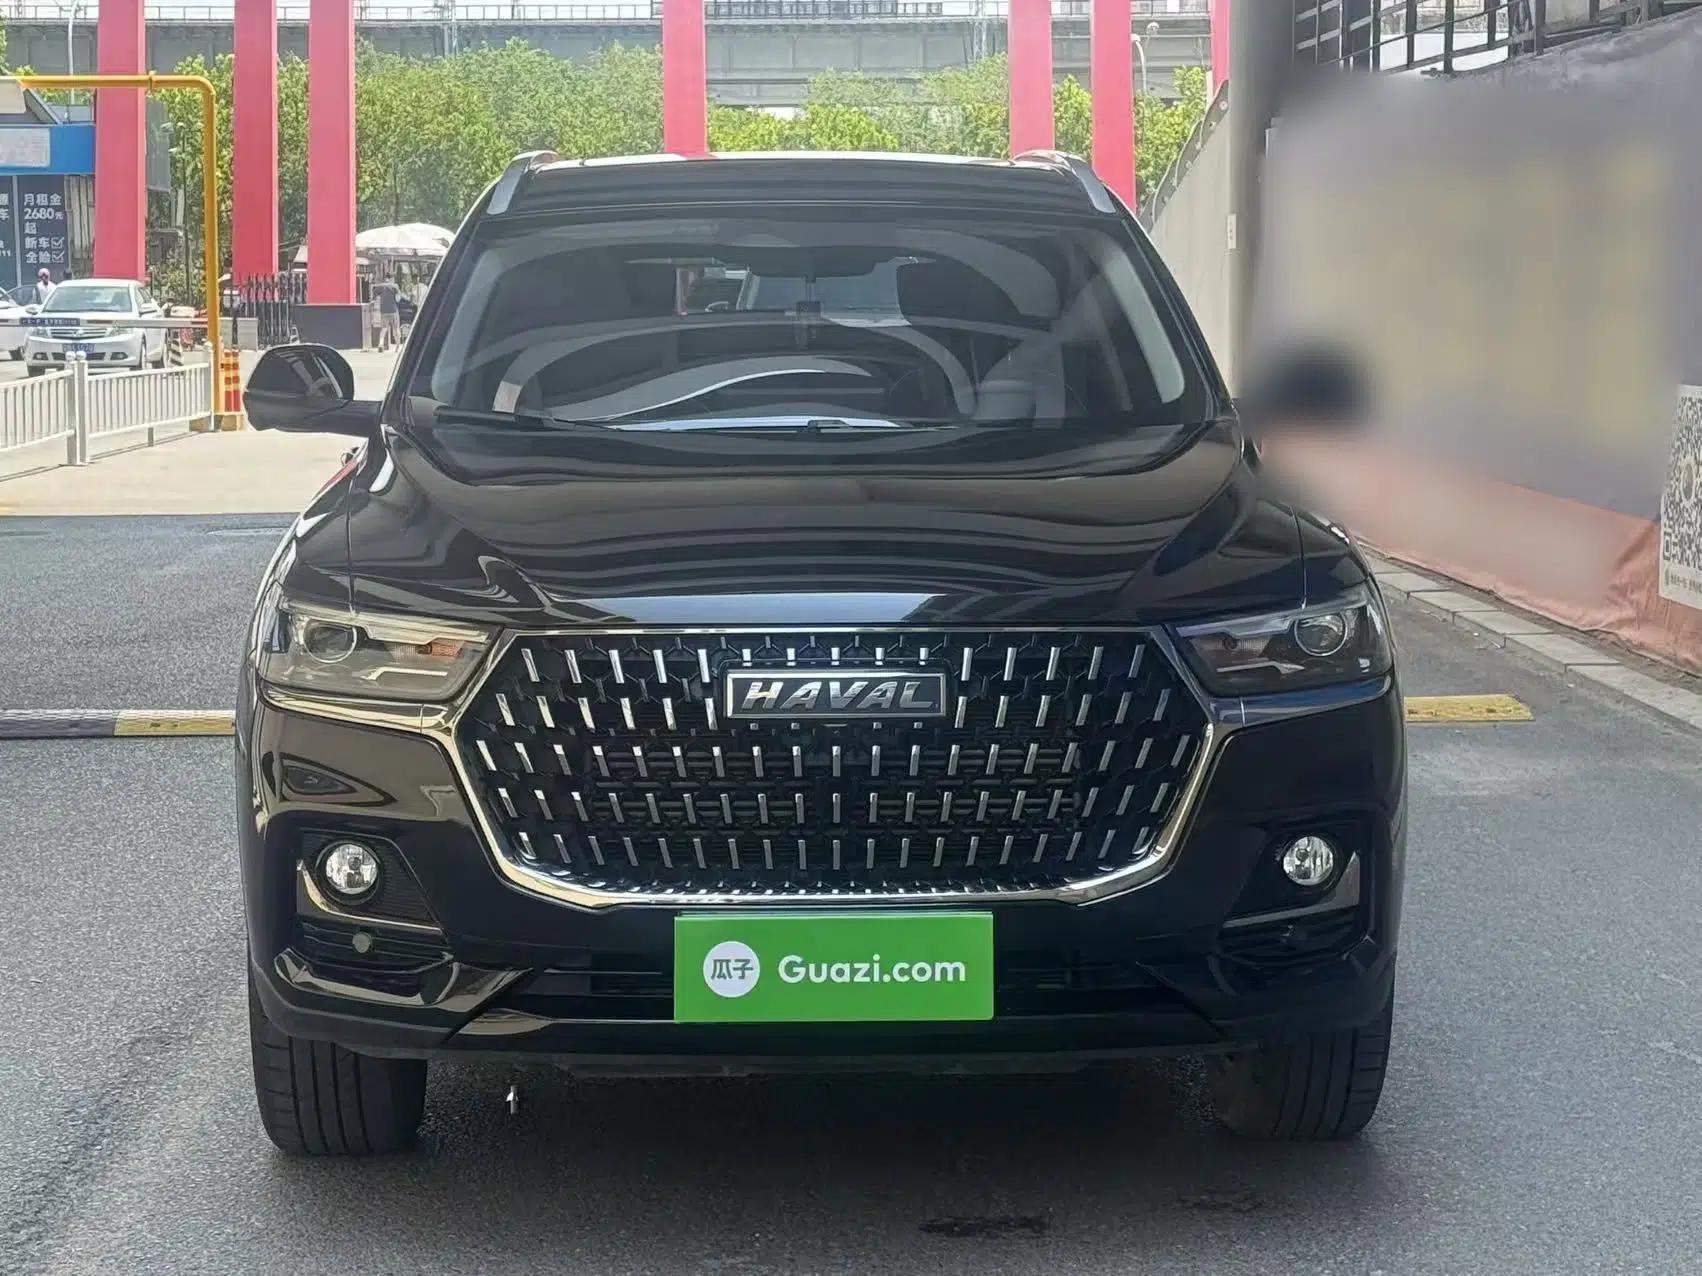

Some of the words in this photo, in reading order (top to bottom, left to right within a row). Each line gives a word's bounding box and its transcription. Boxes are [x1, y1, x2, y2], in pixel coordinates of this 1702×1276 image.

[24, 193, 62, 206] 月租金
[24, 207, 64, 220] 2680元
[24, 222, 37, 234] 起
[24, 237, 50, 249] 新车
[26, 251, 51, 264] 全险
[741, 681, 934, 709] HAVAL
[711, 958, 754, 980] 瓜子
[778, 954, 966, 984] Guazi.com
